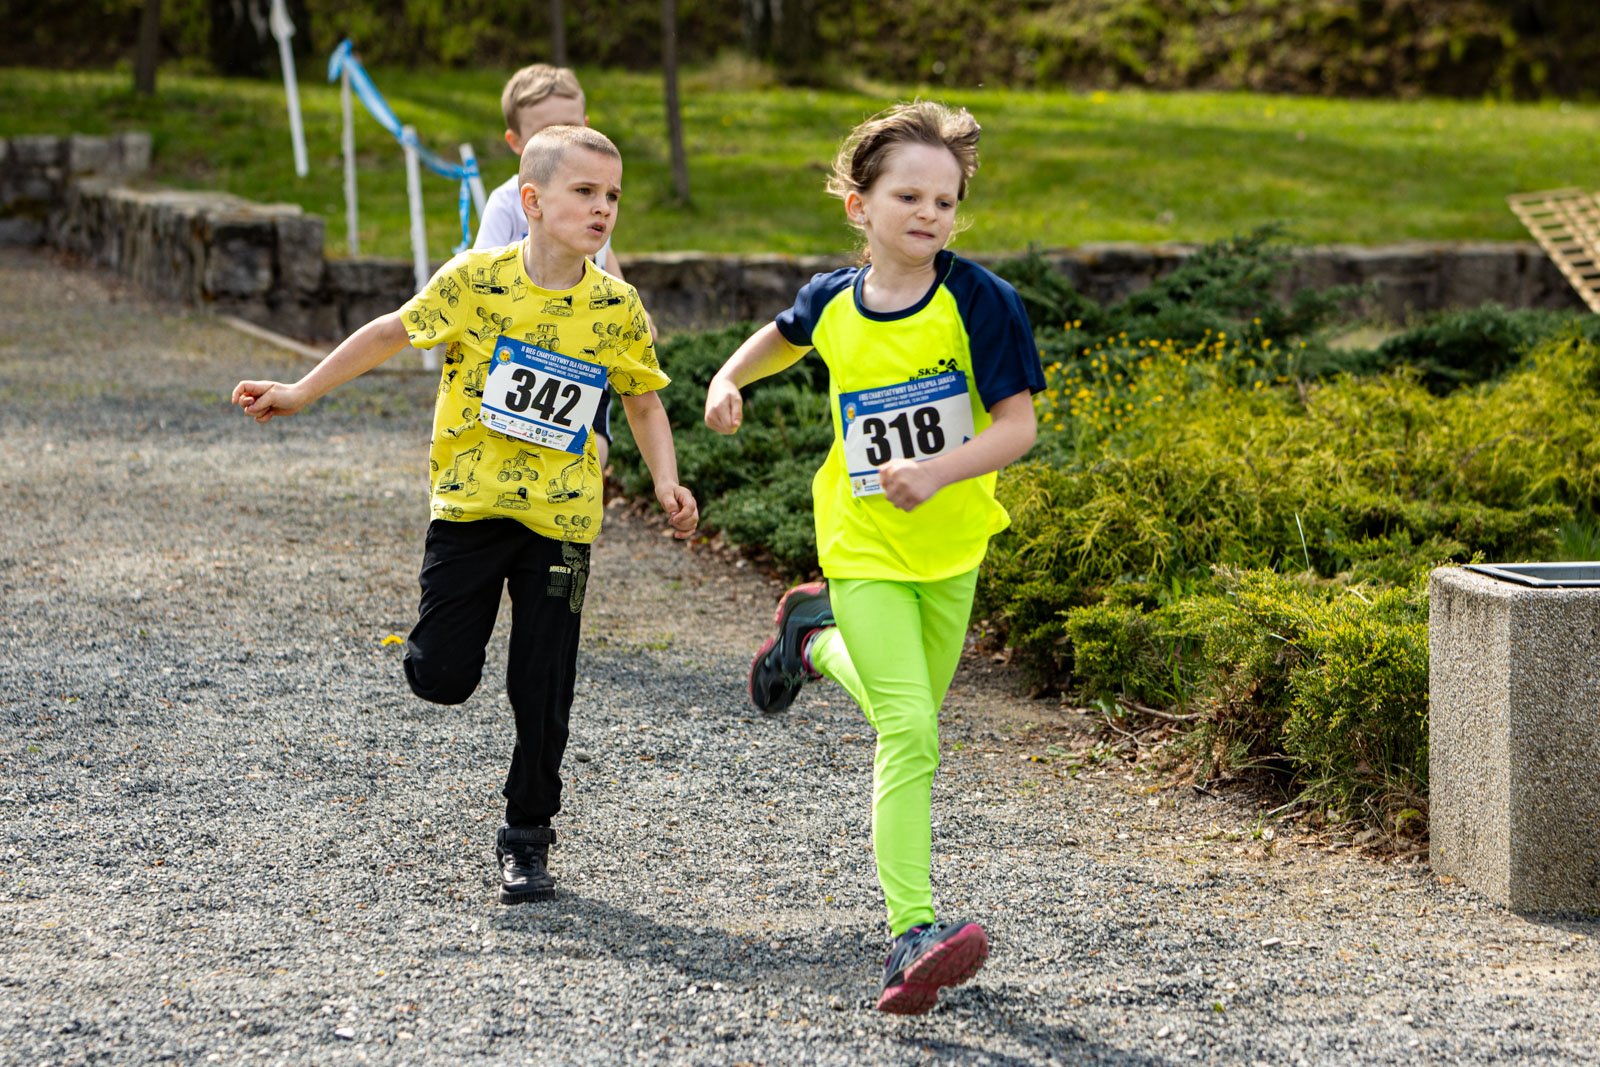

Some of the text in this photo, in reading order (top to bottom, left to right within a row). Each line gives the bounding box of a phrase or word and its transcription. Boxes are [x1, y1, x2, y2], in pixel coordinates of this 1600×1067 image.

[505, 368, 581, 427] 342
[918, 367, 938, 376] SKS
[863, 406, 945, 467] 318
